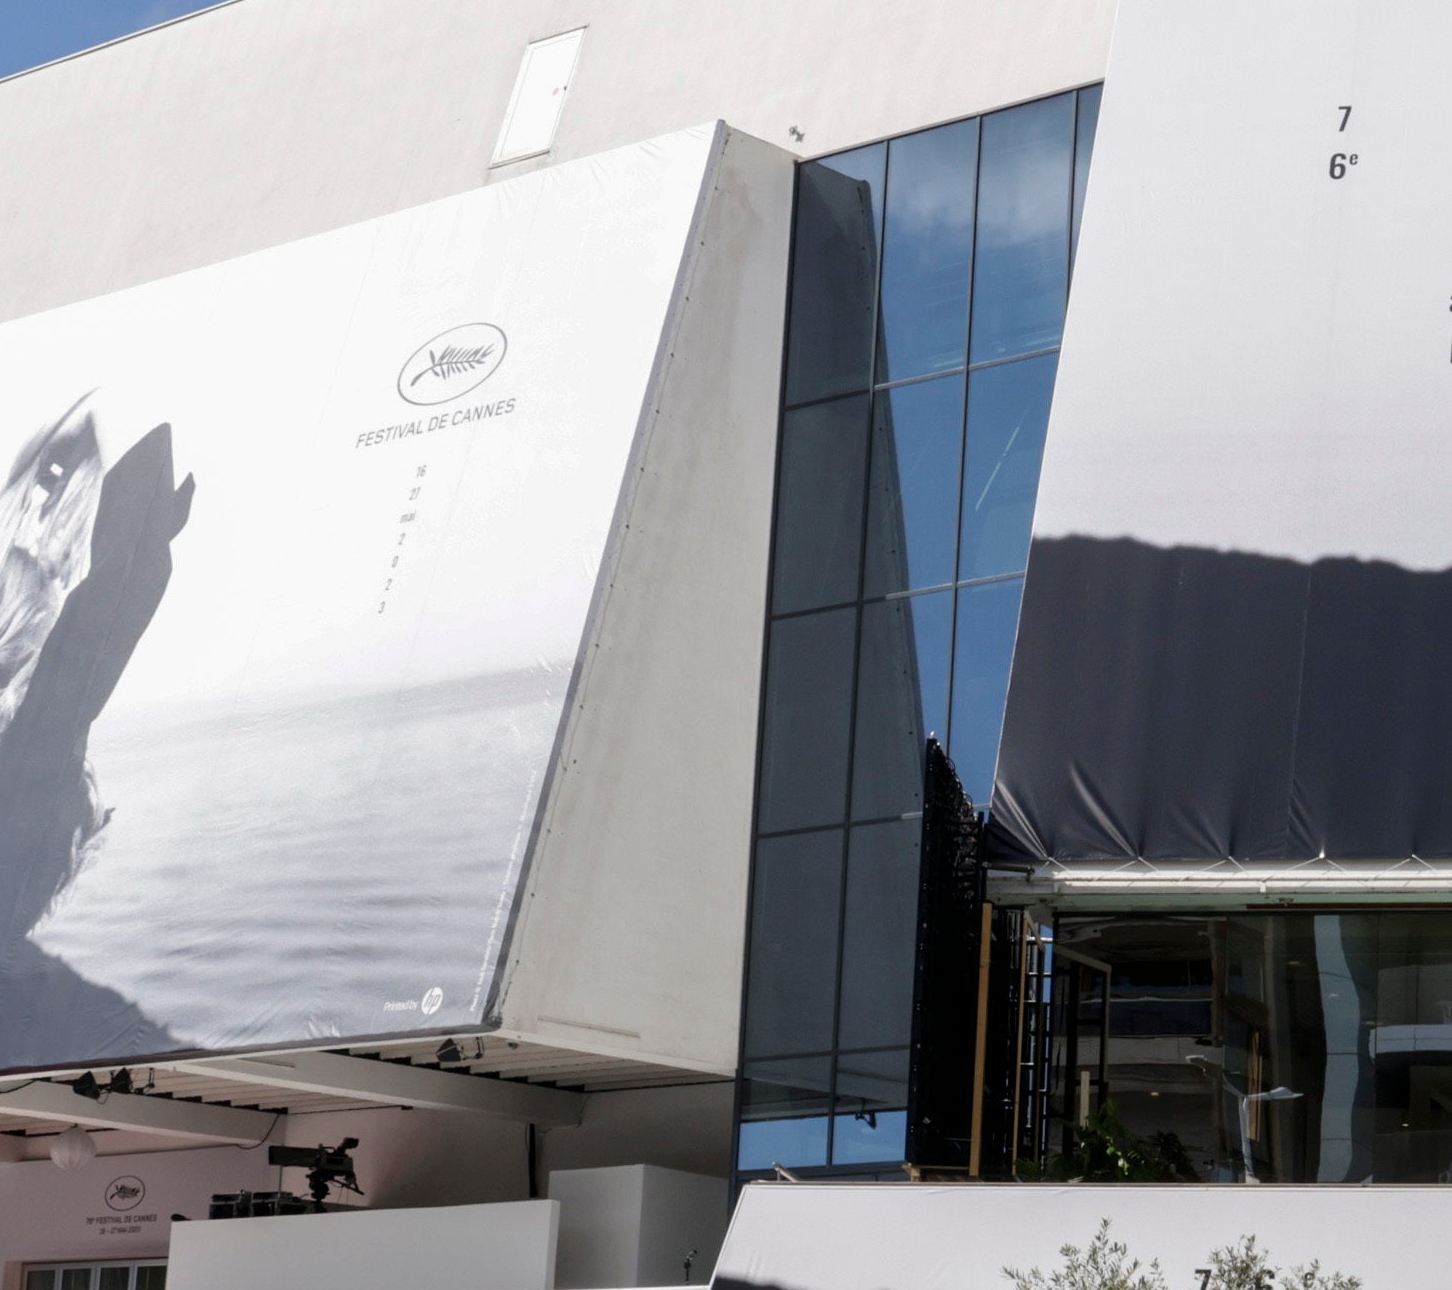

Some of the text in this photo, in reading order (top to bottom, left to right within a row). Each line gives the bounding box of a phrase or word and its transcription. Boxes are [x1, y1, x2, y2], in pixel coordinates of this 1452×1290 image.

[355, 397, 517, 449] FESTIVAL DE CANNES
